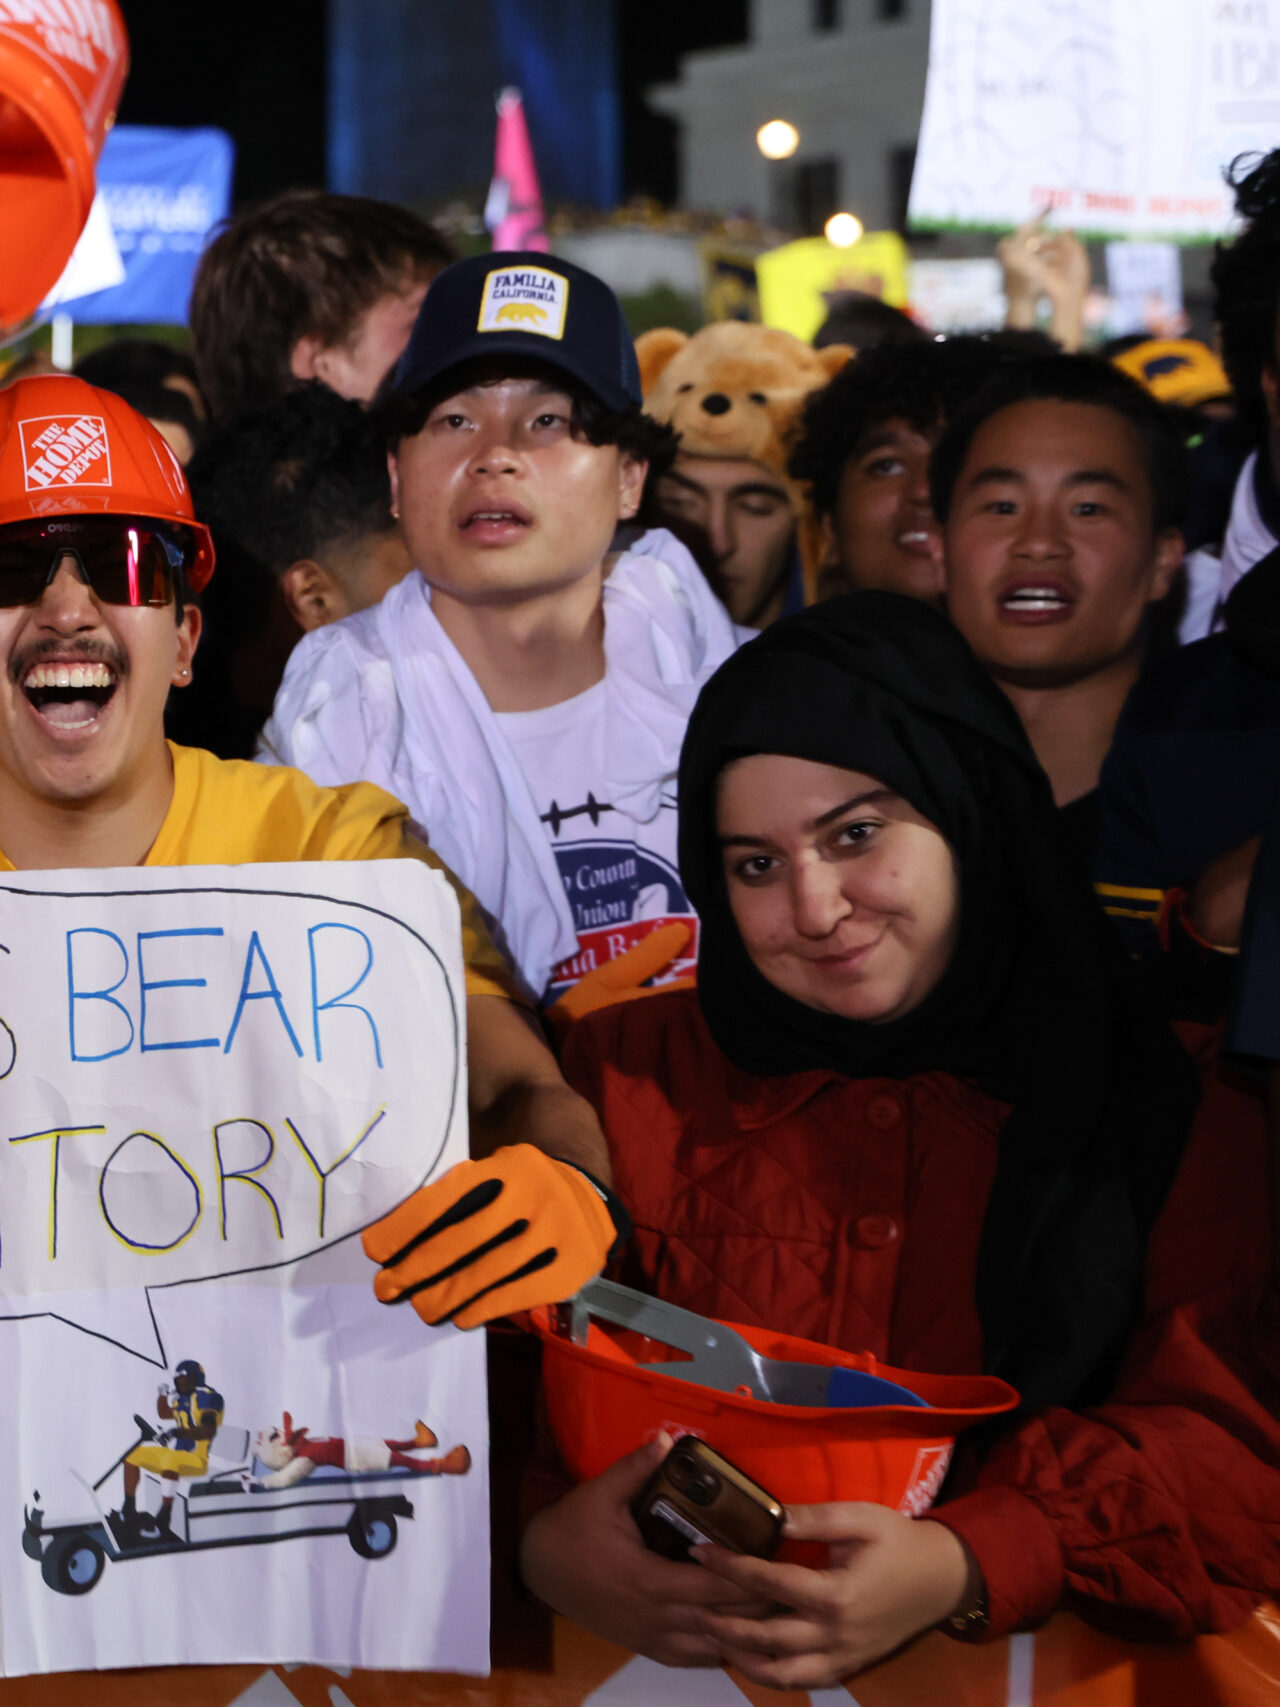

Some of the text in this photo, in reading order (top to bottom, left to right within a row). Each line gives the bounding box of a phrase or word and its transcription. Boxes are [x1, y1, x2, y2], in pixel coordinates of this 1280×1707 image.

[492, 287, 556, 303] CALIFORNIA
[495, 274, 556, 292] FAMILIA
[27, 416, 105, 487] HOME
[31, 423, 66, 450] THE
[59, 439, 107, 485] DEPOT
[66, 923, 385, 1070] BEAR
